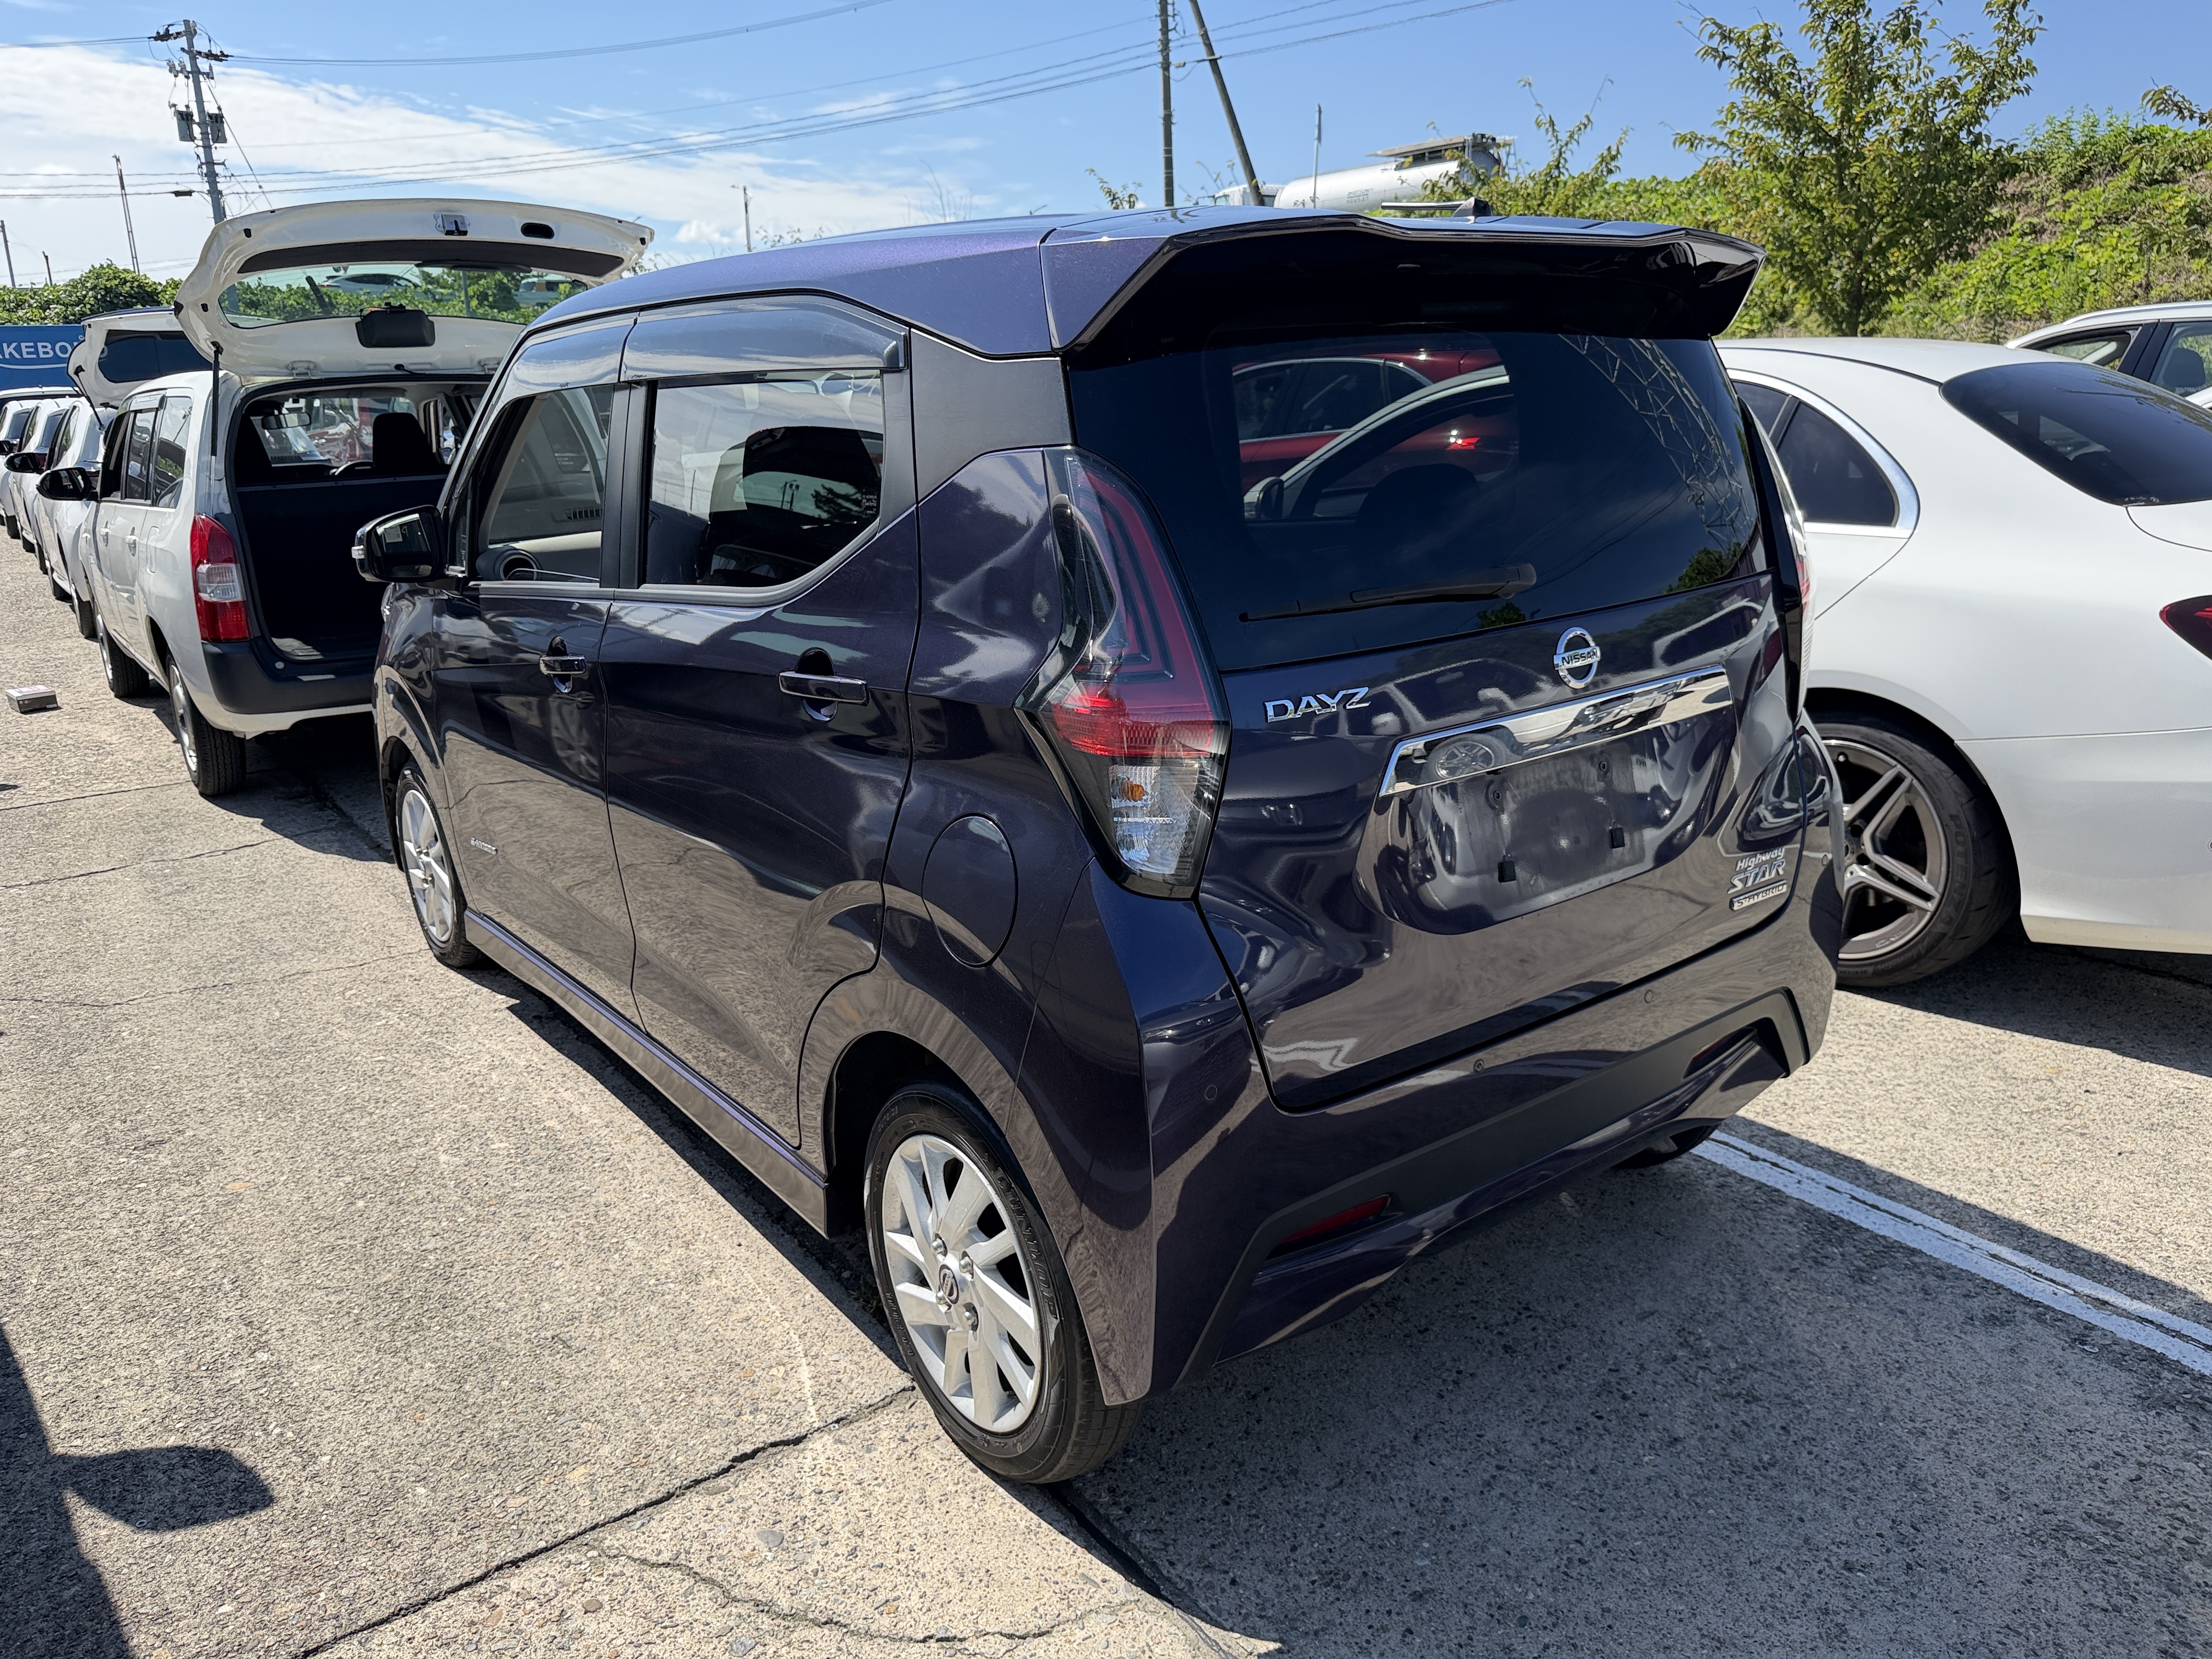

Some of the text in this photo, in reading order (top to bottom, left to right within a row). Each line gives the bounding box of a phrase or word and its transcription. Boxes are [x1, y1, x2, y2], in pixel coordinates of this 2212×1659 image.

[1561, 648, 1598, 666] NISSAN
[1264, 686, 1372, 723] DAYZ
[1727, 858, 1786, 894] STAR
[1735, 847, 1785, 871] Highway
[1939, 814, 1968, 927] POTENZA
